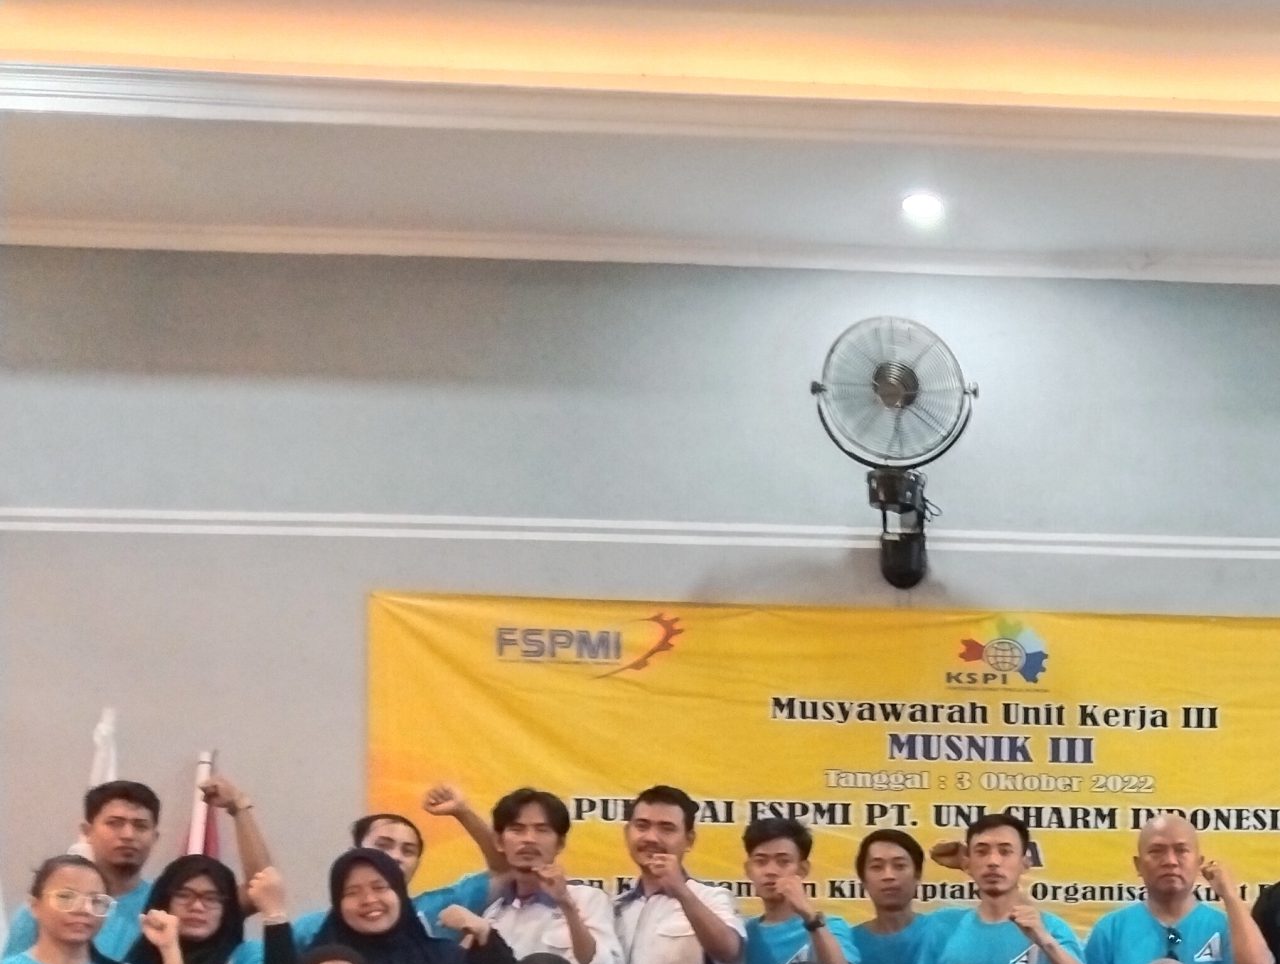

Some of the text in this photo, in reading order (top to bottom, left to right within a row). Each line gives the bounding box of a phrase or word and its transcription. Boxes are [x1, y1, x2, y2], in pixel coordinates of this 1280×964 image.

[496, 627, 621, 659] FSPMI
[946, 671, 1008, 685] KSPI
[771, 697, 1218, 731] Musyawarah Unit Kerja III
[888, 733, 1094, 764] MUSNIK III
[823, 768, 931, 792] Tanggal
[955, 771, 972, 791] 3
[980, 771, 1083, 793] Oktober
[1089, 774, 1155, 794] 2022
[865, 803, 919, 828] PT.
